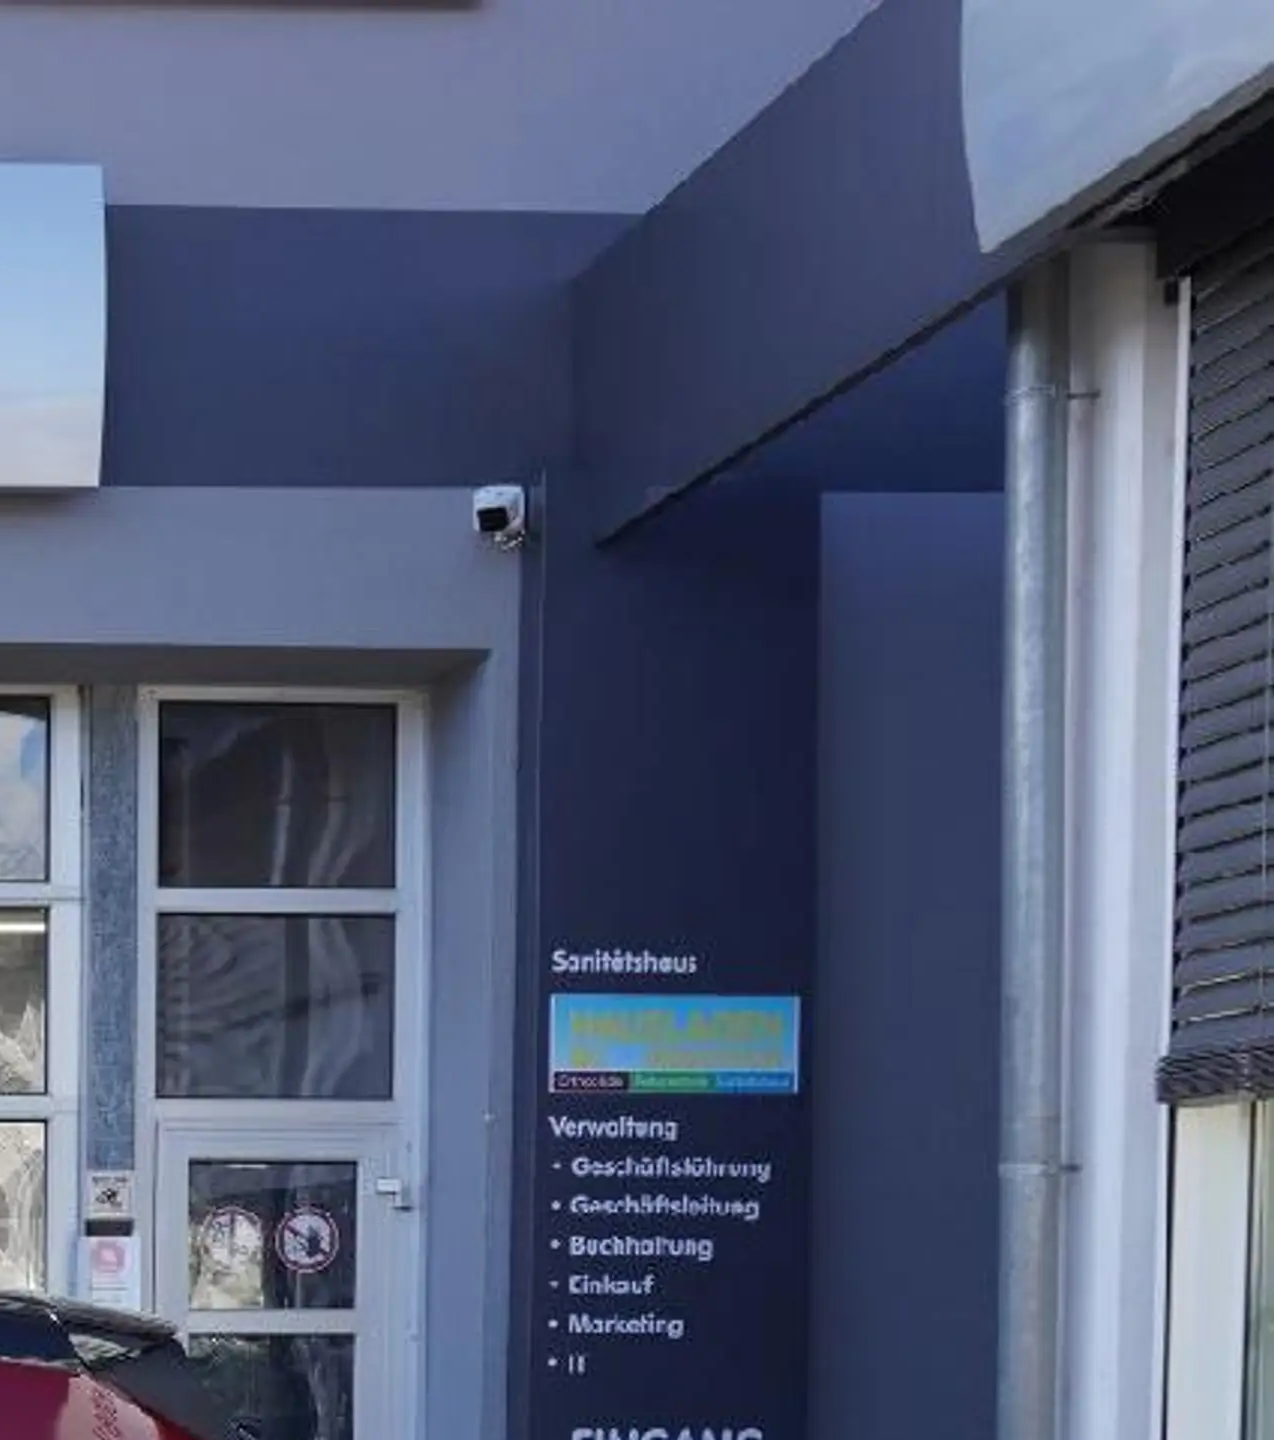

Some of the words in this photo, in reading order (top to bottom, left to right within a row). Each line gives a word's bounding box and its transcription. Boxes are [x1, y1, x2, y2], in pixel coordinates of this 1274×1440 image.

[551, 948, 698, 974] Sanitätshaus
[548, 1115, 678, 1142] Verwaltung
[570, 1155, 772, 1183] Geschäftsführung
[569, 1193, 760, 1221] Geschäftsleitung
[569, 1235, 714, 1262] Buchhaltung
[568, 1273, 655, 1295] Einkauf
[568, 1312, 685, 1339] Marketing
